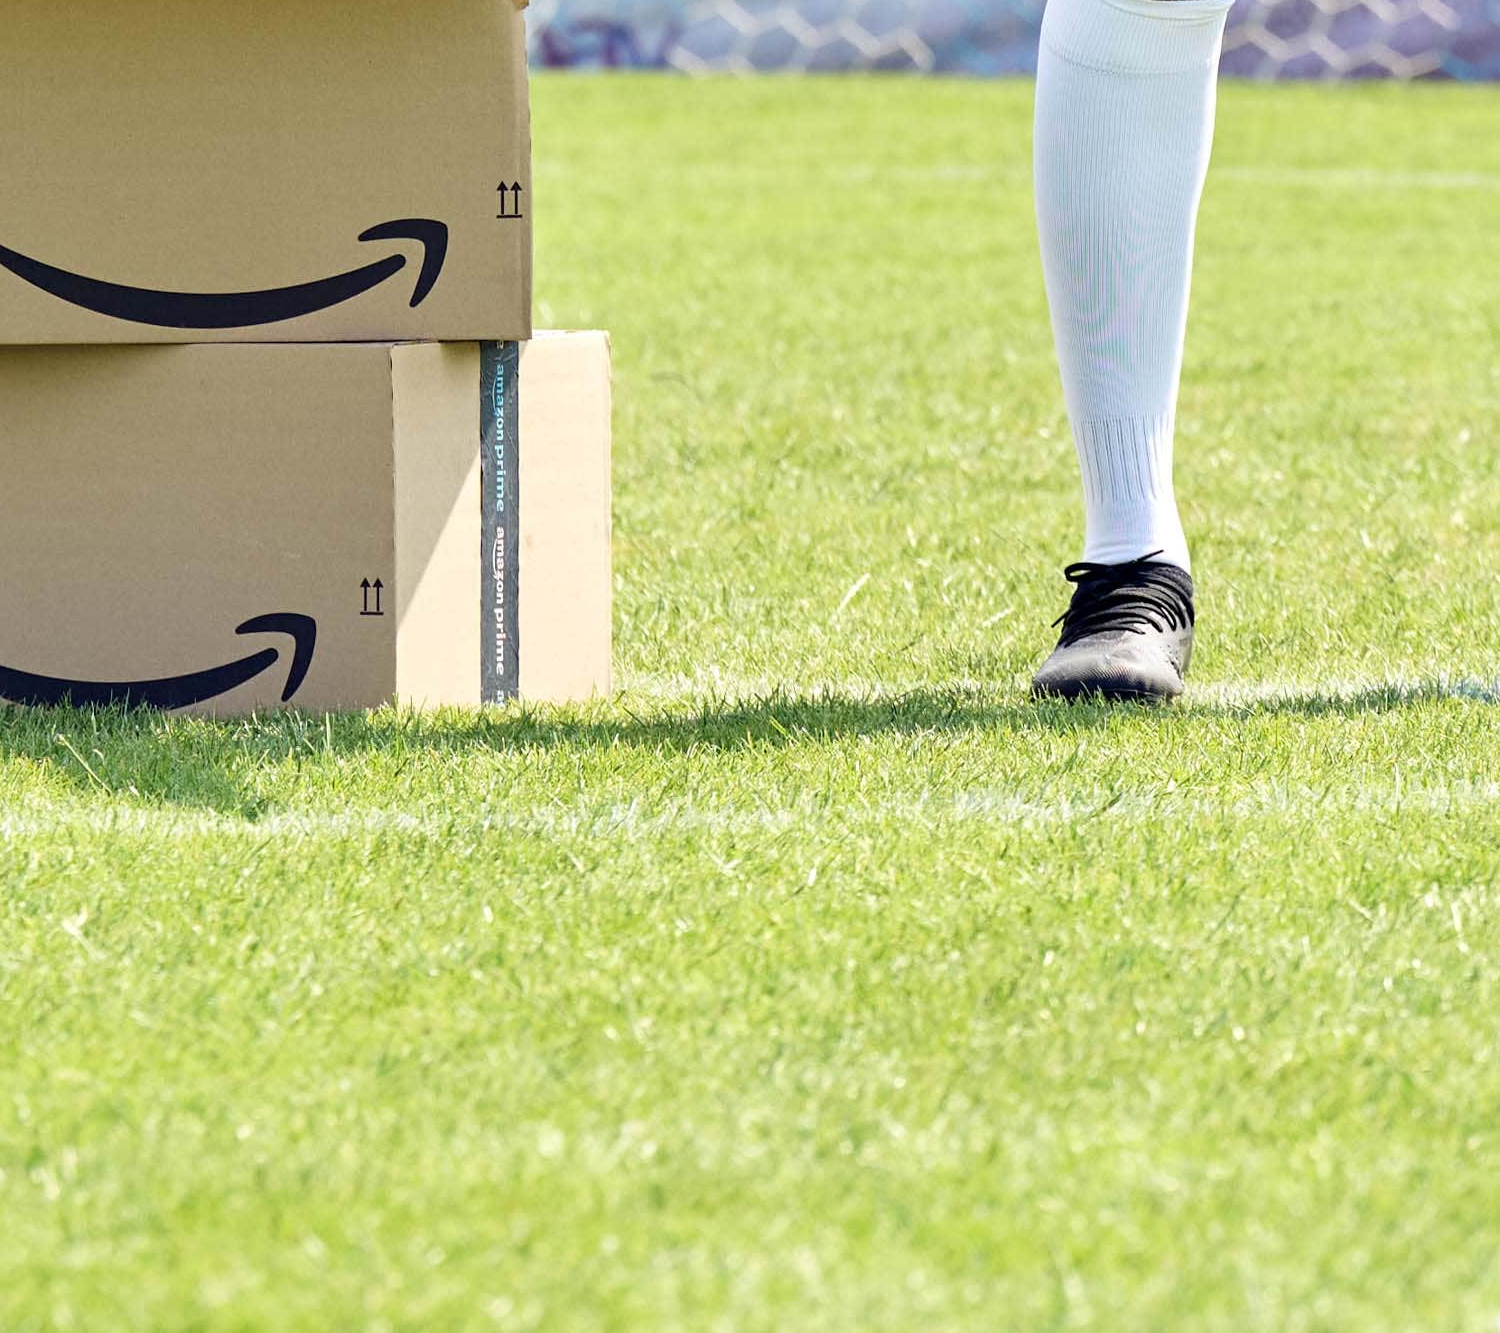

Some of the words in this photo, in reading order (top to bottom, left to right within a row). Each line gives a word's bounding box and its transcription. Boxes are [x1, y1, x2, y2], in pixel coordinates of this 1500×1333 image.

[492, 364, 505, 441] amazon
[494, 444, 507, 512] prime
[492, 526, 505, 605] amazon
[493, 607, 507, 676] prime
